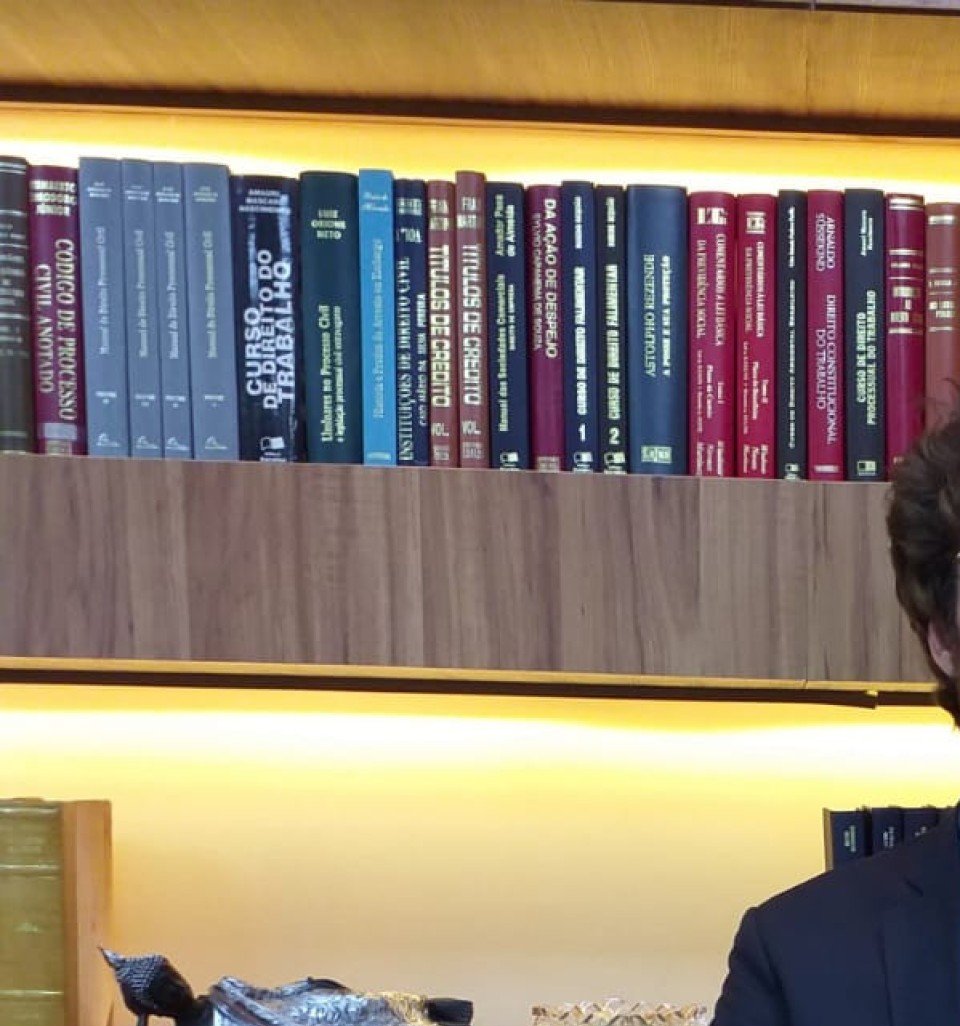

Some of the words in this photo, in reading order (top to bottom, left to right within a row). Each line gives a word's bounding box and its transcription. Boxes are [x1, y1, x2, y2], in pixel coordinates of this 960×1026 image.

[543, 198, 557, 220] DA
[257, 250, 273, 280] DO
[541, 222, 559, 266] AÇÃO
[826, 216, 837, 269] ARNALDO
[37, 263, 52, 309] CIVIL
[55, 239, 76, 304] CÓDIGO
[397, 256, 411, 294] CIVIL
[544, 268, 558, 288] DE
[57, 309, 76, 328] DE
[259, 287, 277, 374] DIREITO
[272, 261, 295, 403] TRABALHO
[318, 304, 331, 328] Civil
[397, 296, 411, 349] DIREITO
[430, 313, 451, 336] DE
[462, 311, 482, 334] DE
[544, 292, 558, 358] DESPEJO
[826, 294, 838, 341] DIREITO
[866, 290, 877, 342] TRABALHO
[38, 316, 54, 393] ANOTADO
[244, 307, 262, 396] CURSO
[319, 332, 331, 375] Processo
[397, 353, 411, 369] DE
[644, 312, 656, 377] ASTOLPHO
[816, 330, 827, 348] DO
[57, 336, 77, 420] PROCESSO
[263, 382, 278, 409] DE
[816, 350, 827, 410] TRABALHO
[826, 342, 838, 445] CONSTITUCIONAL
[579, 424, 587, 441] 1
[609, 428, 621, 444] 2
